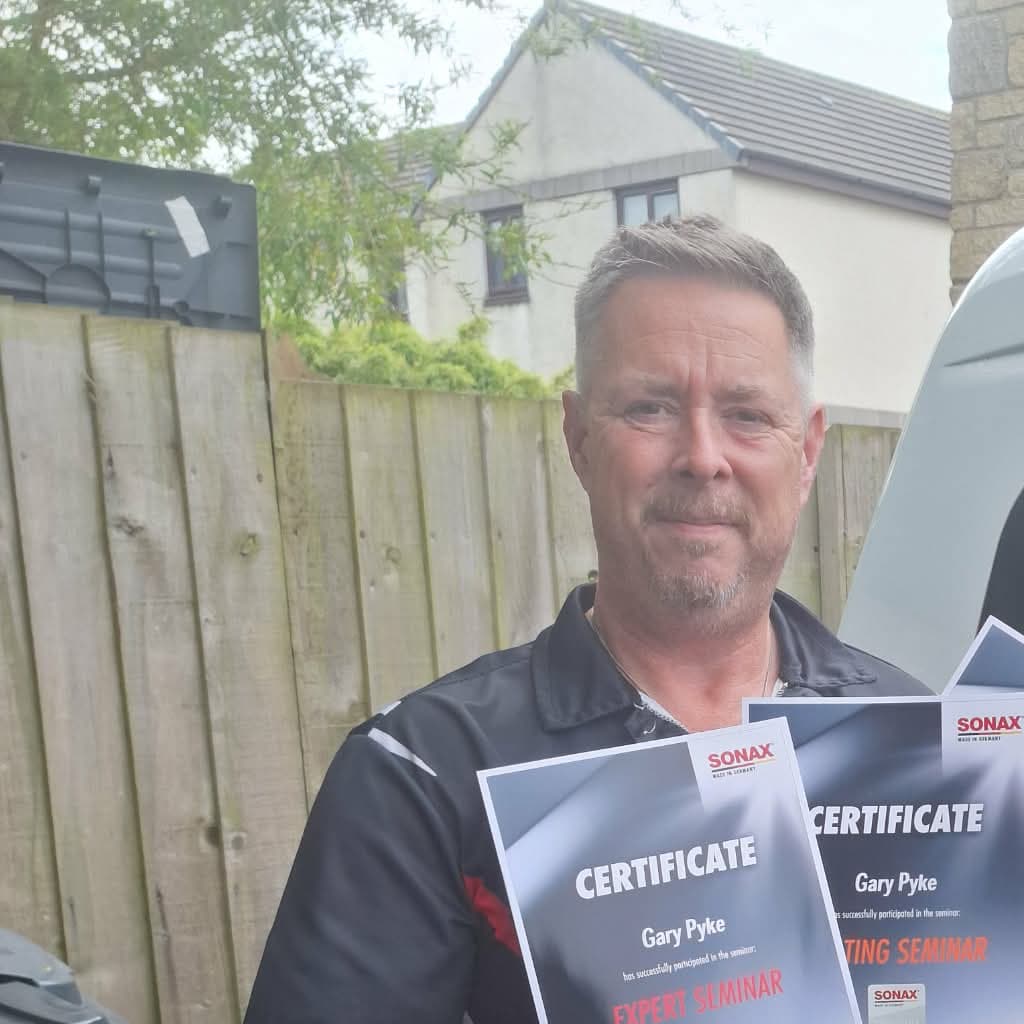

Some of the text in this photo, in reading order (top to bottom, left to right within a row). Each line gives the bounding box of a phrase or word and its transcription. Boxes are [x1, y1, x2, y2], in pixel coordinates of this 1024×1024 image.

[957, 715, 1021, 732] SONAX
[707, 743, 774, 768] SONAX
[575, 835, 758, 900] CERTIFICATE
[855, 871, 937, 897] Gary Pyke
[843, 909, 878, 920] successfully
[879, 908, 914, 920] participated
[923, 907, 934, 917] the
[642, 915, 726, 948] Gary Pyke
[636, 963, 672, 978] successfully
[673, 954, 709, 972] participated
[718, 949, 729, 961] the
[844, 936, 989, 965] TING SEMINAR
[694, 968, 783, 1014] SEMINAR
[874, 990, 918, 1001] SONAX
